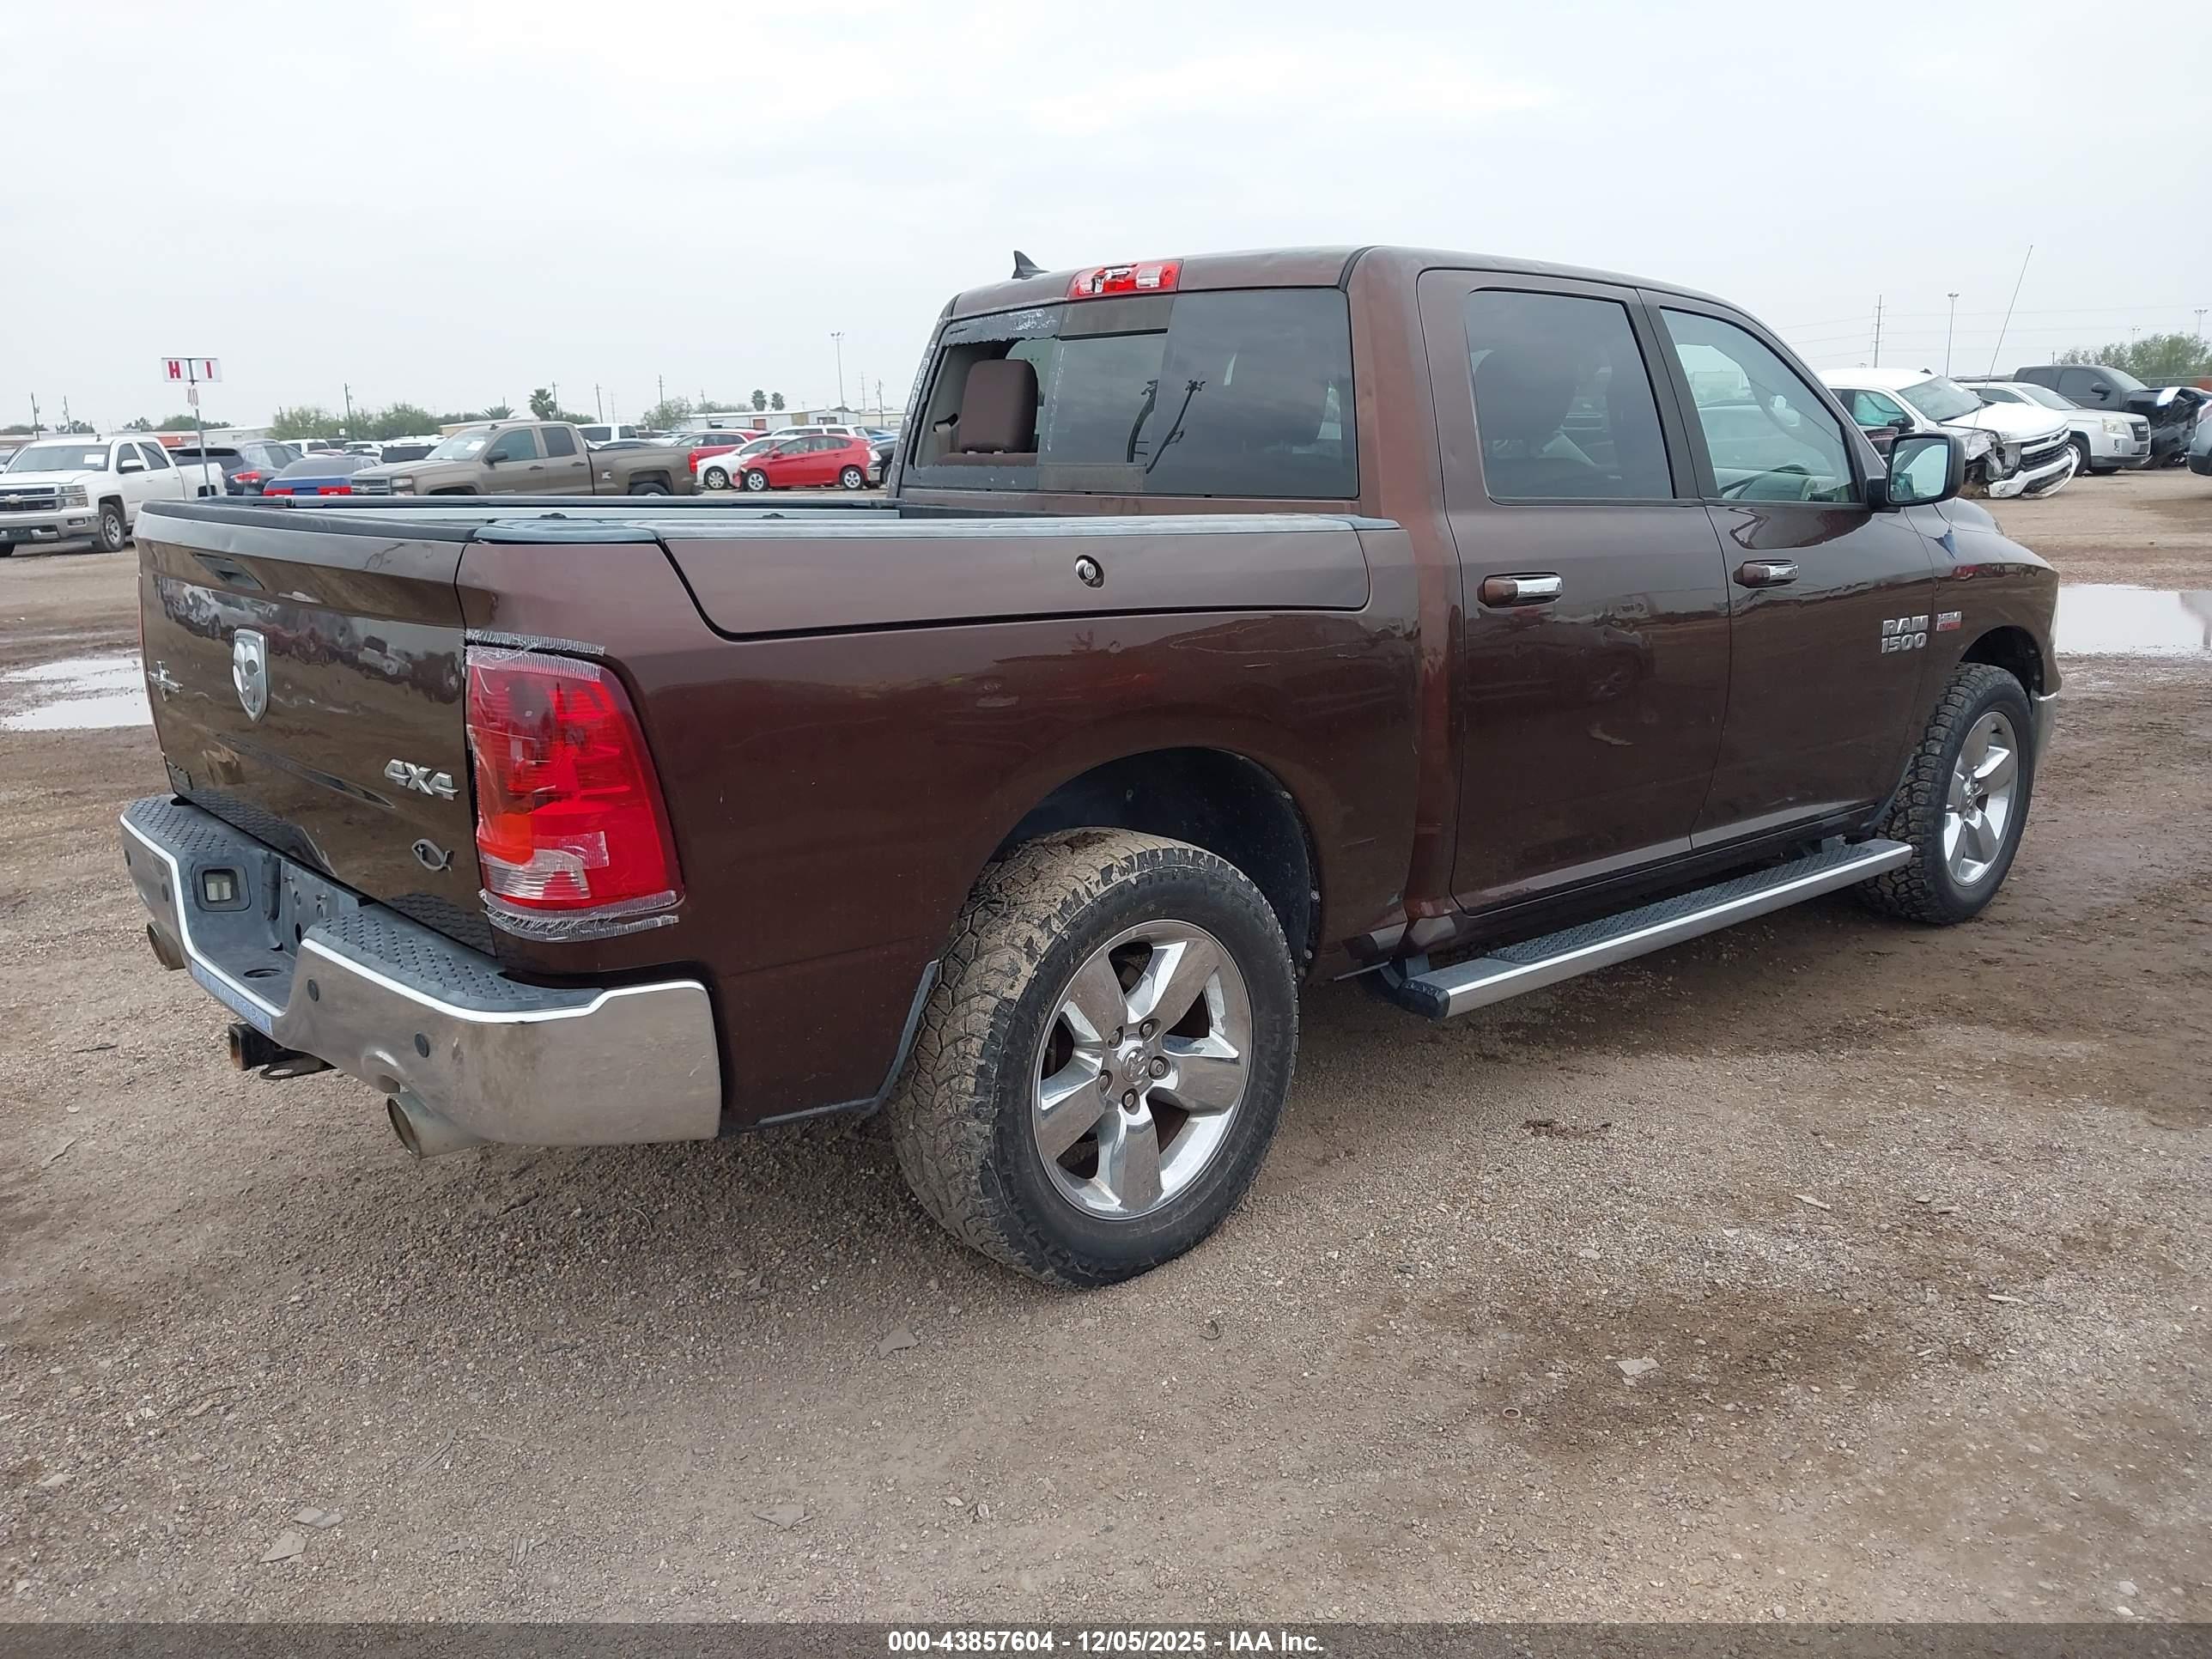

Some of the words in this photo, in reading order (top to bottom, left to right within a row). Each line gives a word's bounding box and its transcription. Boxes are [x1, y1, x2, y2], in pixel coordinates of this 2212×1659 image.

[167, 360, 181, 380] H
[1882, 615, 1929, 635] RAM
[1881, 632, 1927, 653] 1500
